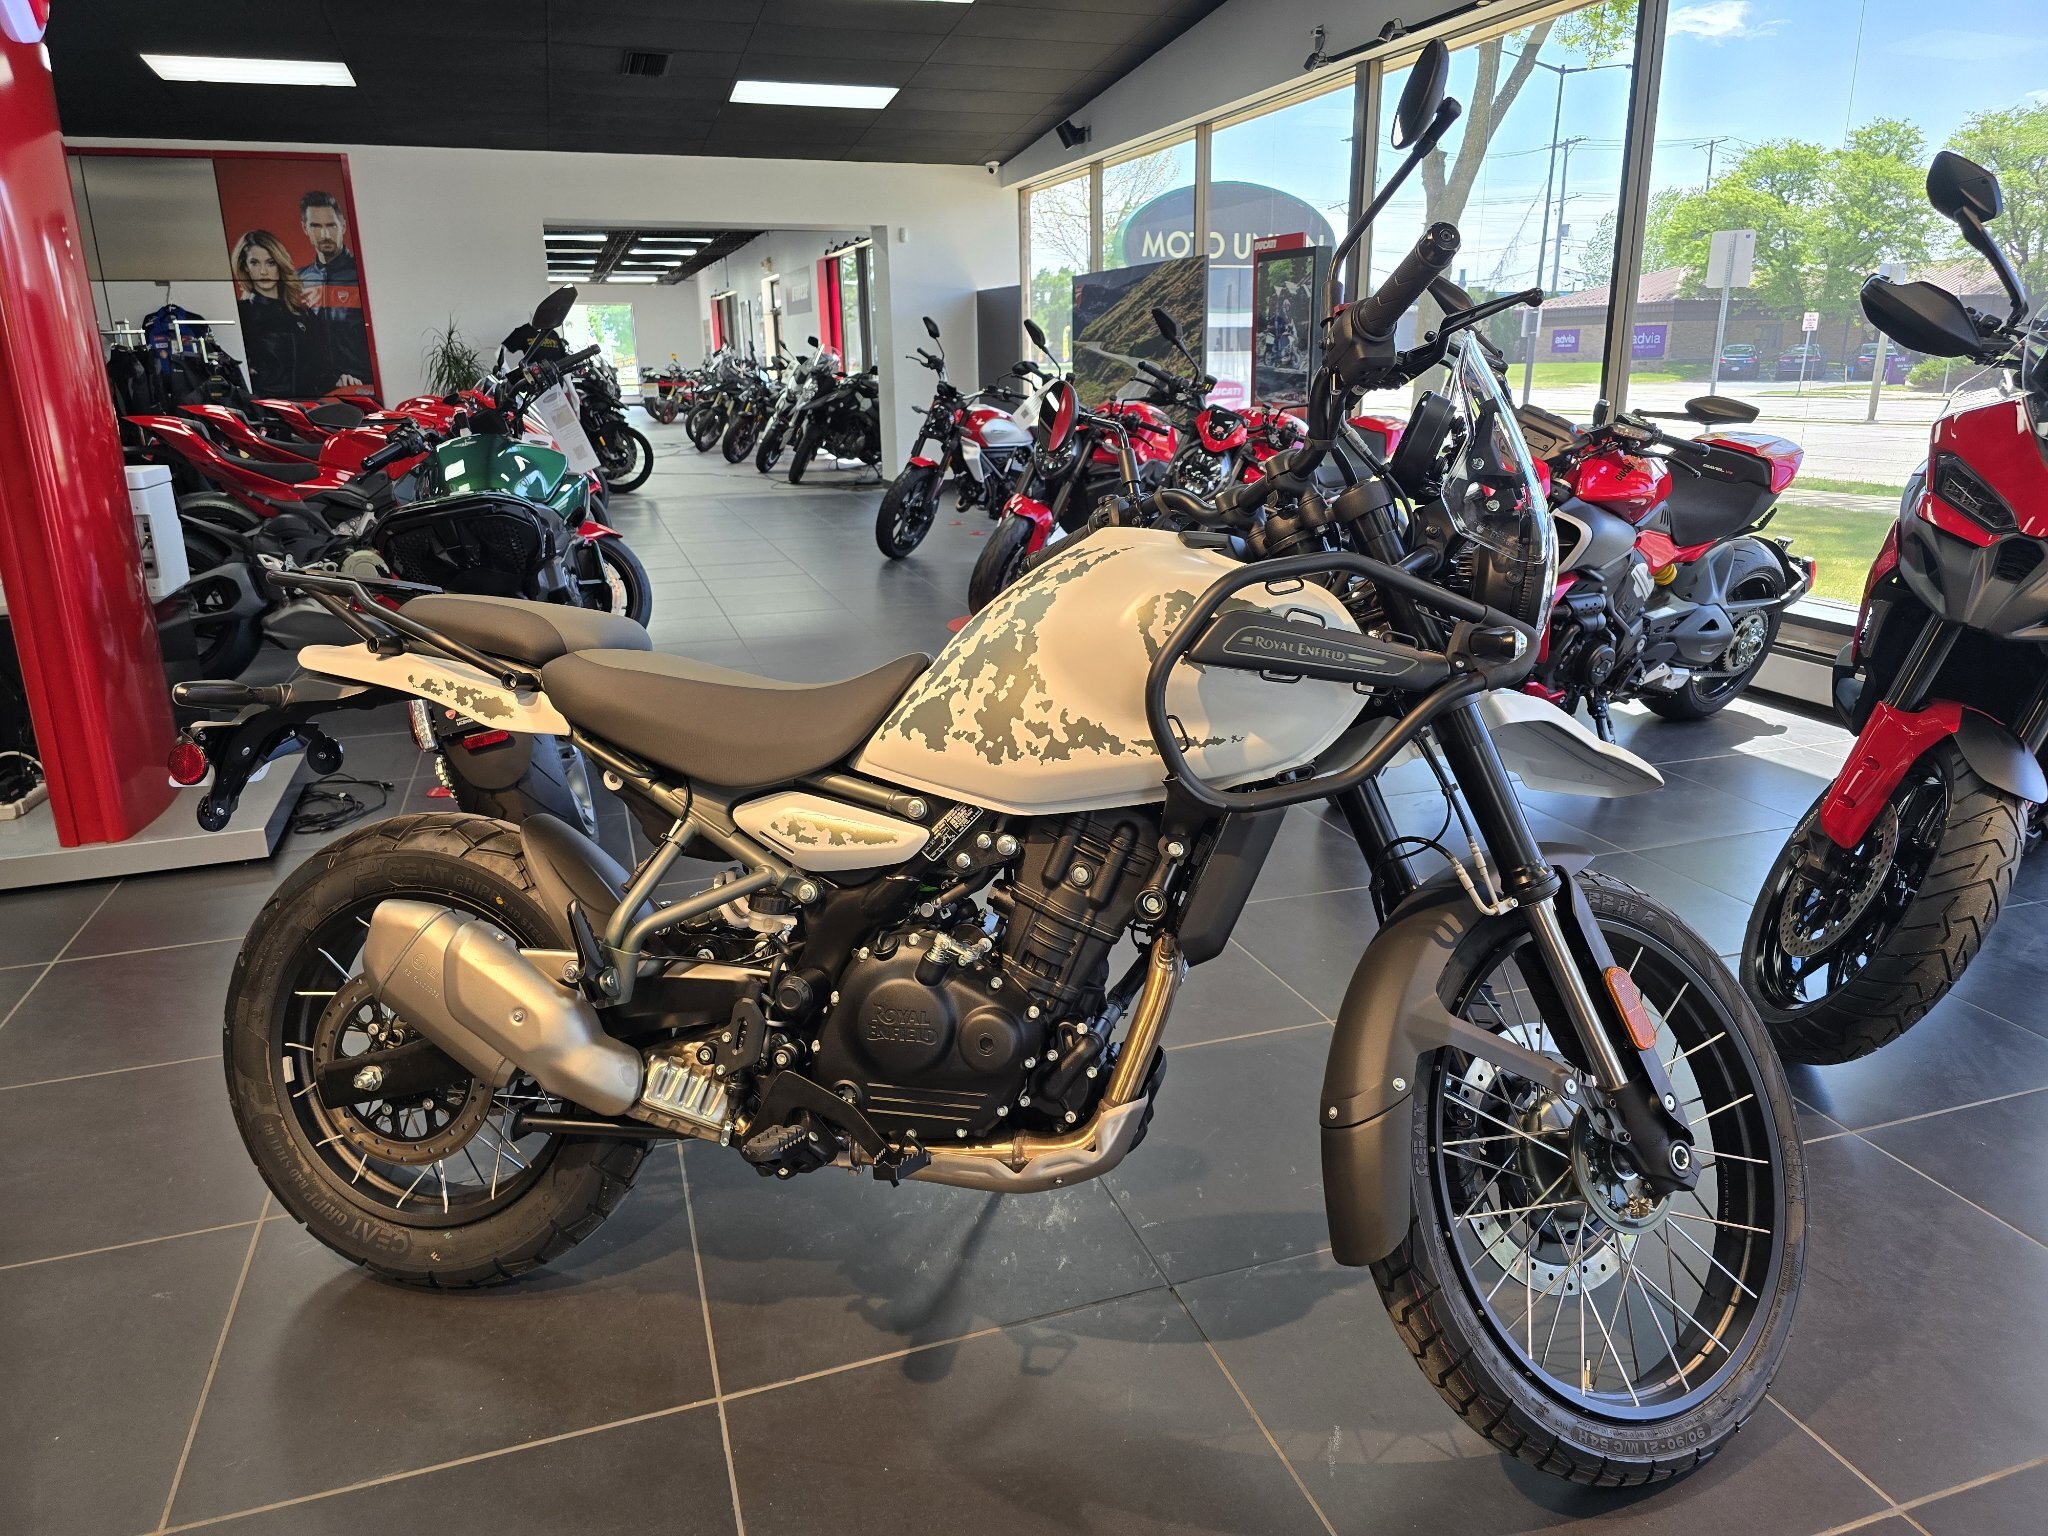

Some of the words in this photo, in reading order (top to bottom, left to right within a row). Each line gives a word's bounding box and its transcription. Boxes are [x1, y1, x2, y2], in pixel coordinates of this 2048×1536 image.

[1141, 230, 1225, 259] MOO
[1554, 333, 1575, 344] advia
[1254, 635, 1294, 652] ROYAL
[1298, 642, 1346, 662] ENFIELD
[873, 1002, 930, 1026] ROYAL
[867, 1022, 939, 1046] ENFIELD
[304, 1189, 348, 1226] GRIPP
[345, 1218, 410, 1255] CEAT
[1579, 1431, 1610, 1450] 54H
